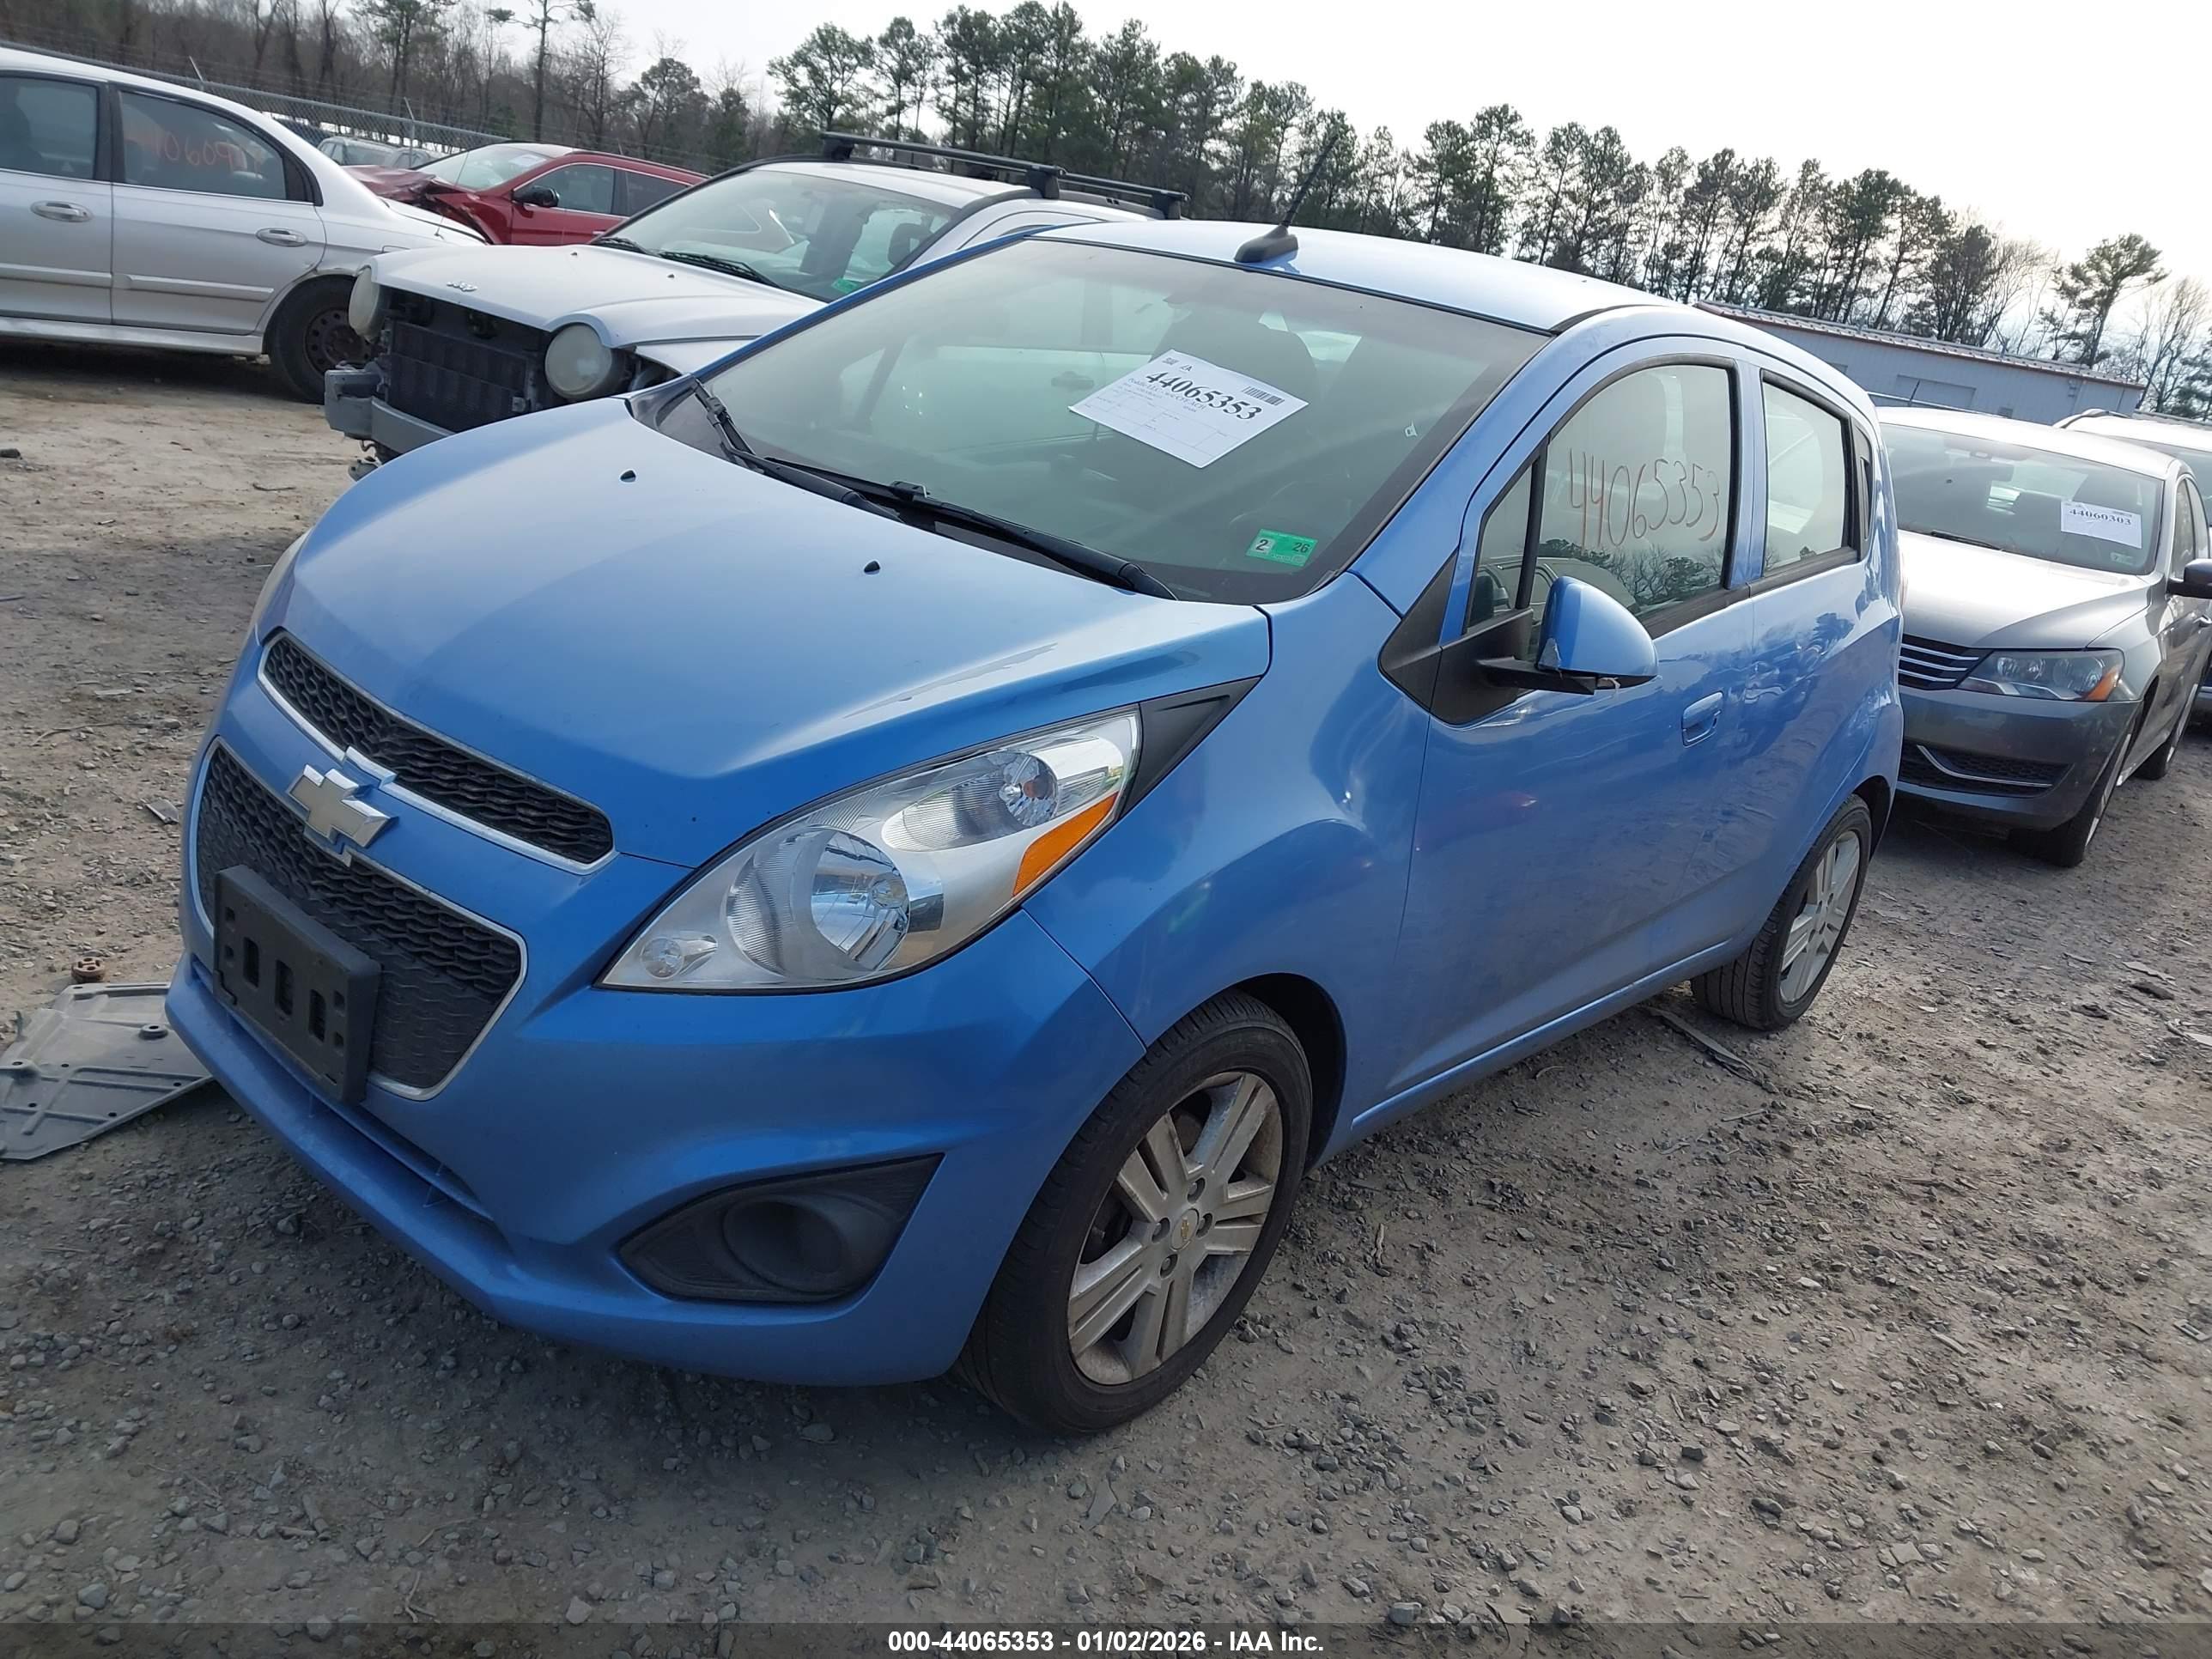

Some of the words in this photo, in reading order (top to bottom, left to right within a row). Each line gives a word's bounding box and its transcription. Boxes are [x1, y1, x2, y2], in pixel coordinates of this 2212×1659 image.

[1146, 372, 1262, 420] 44065353
[1569, 447, 1720, 556] 44065353
[2069, 508, 2132, 526] 44060303
[1255, 539, 1268, 551] 2
[1291, 542, 1310, 553] 26
